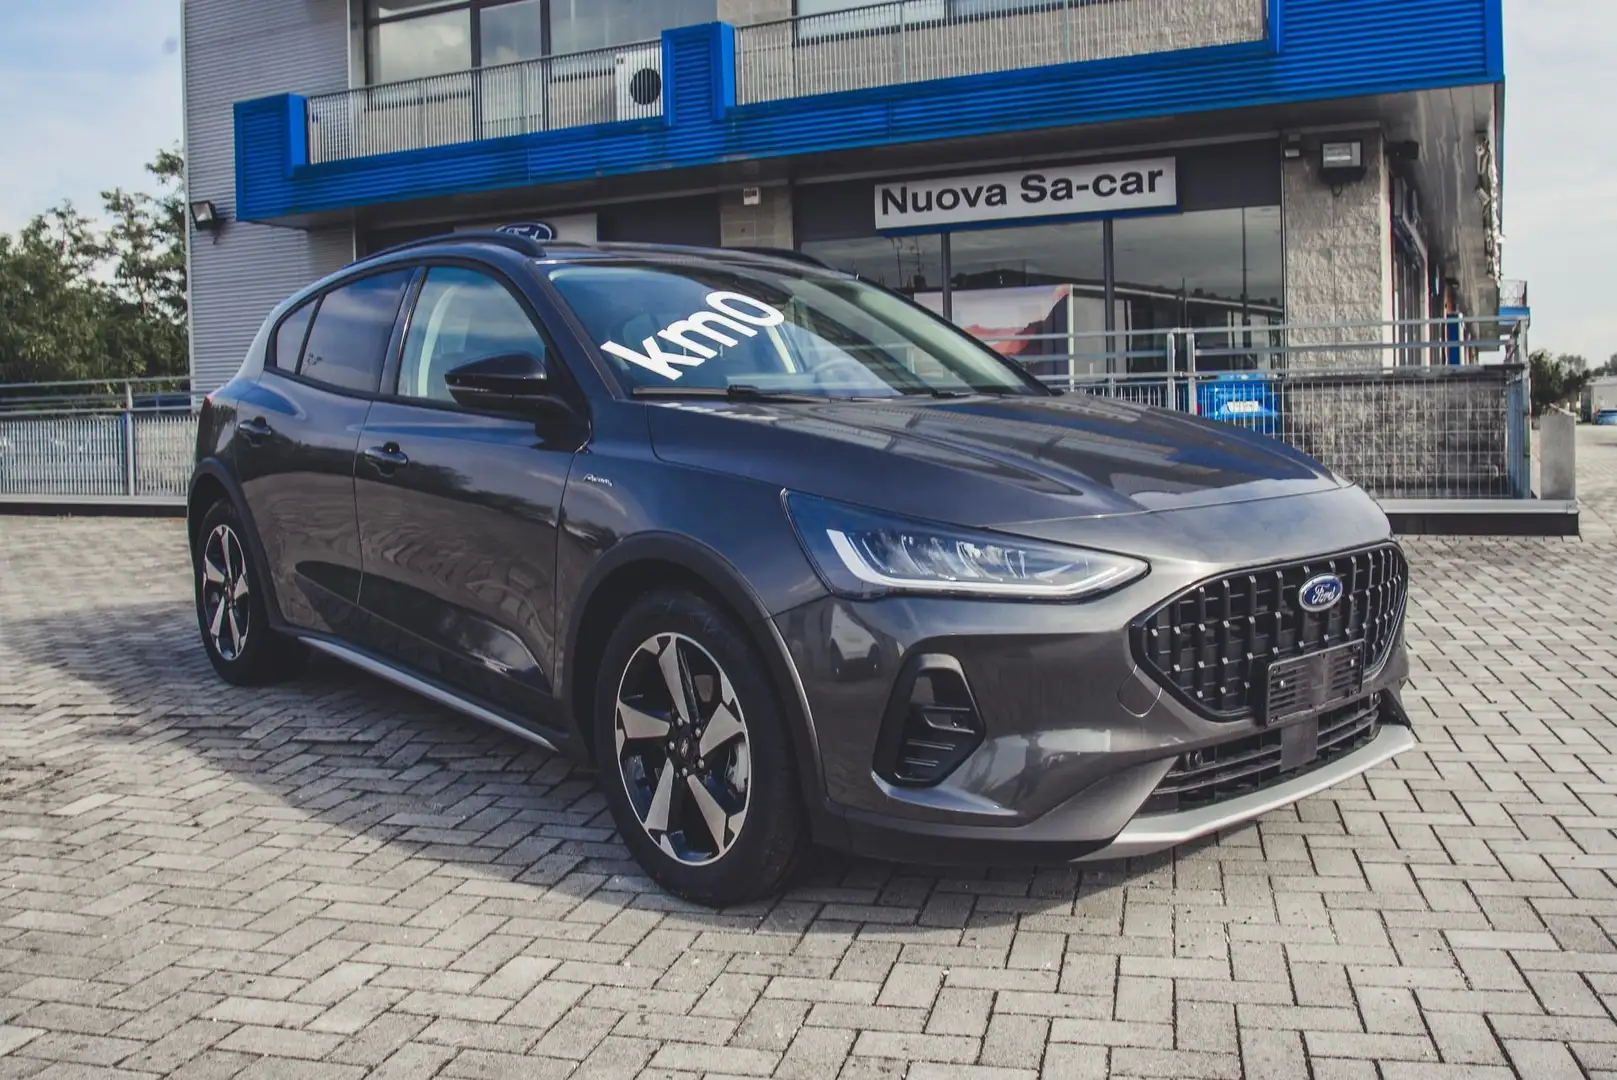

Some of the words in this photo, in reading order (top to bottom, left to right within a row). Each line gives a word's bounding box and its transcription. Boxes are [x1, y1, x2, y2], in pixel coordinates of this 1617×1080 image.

[881, 183, 1007, 215] Nuova
[1020, 169, 1163, 203] Sa-car
[1311, 583, 1336, 604] Ford
